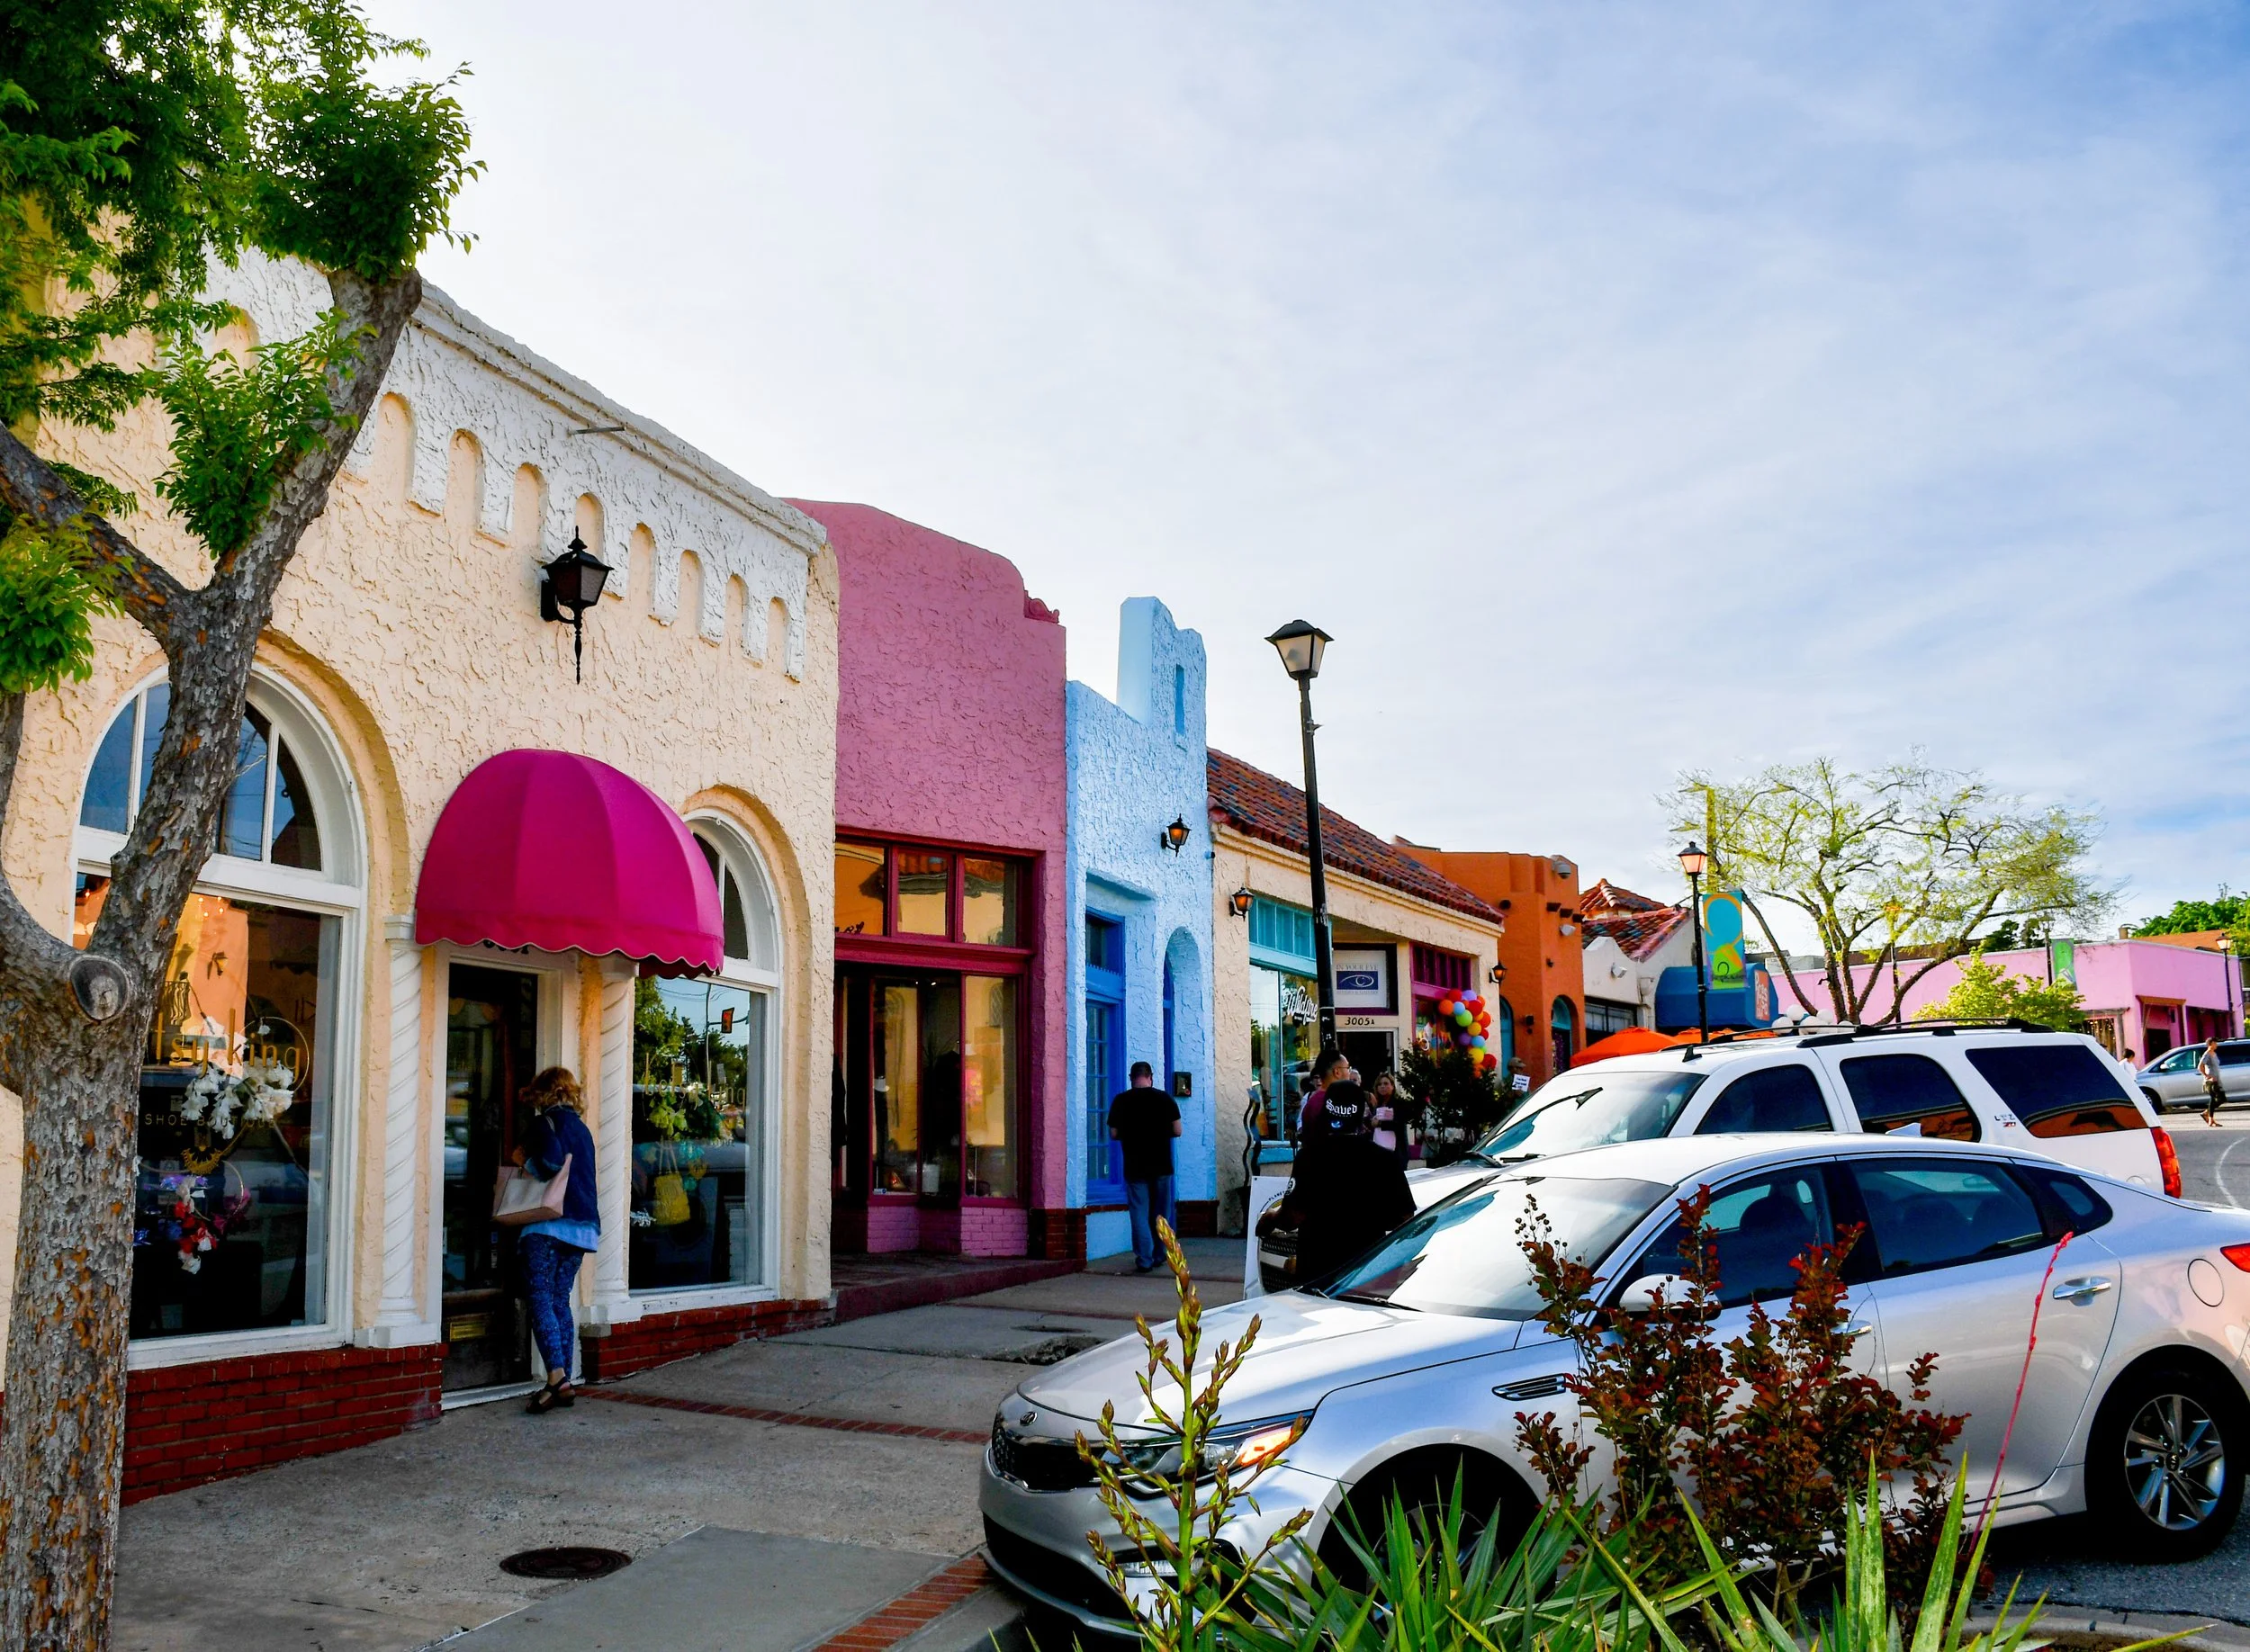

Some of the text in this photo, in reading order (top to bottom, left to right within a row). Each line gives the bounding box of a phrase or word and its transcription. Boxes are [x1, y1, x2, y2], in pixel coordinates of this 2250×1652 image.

[151, 1008, 301, 1083] tsy king
[1326, 1099, 1357, 1115] Saved
[144, 1113, 188, 1127] SHOE
